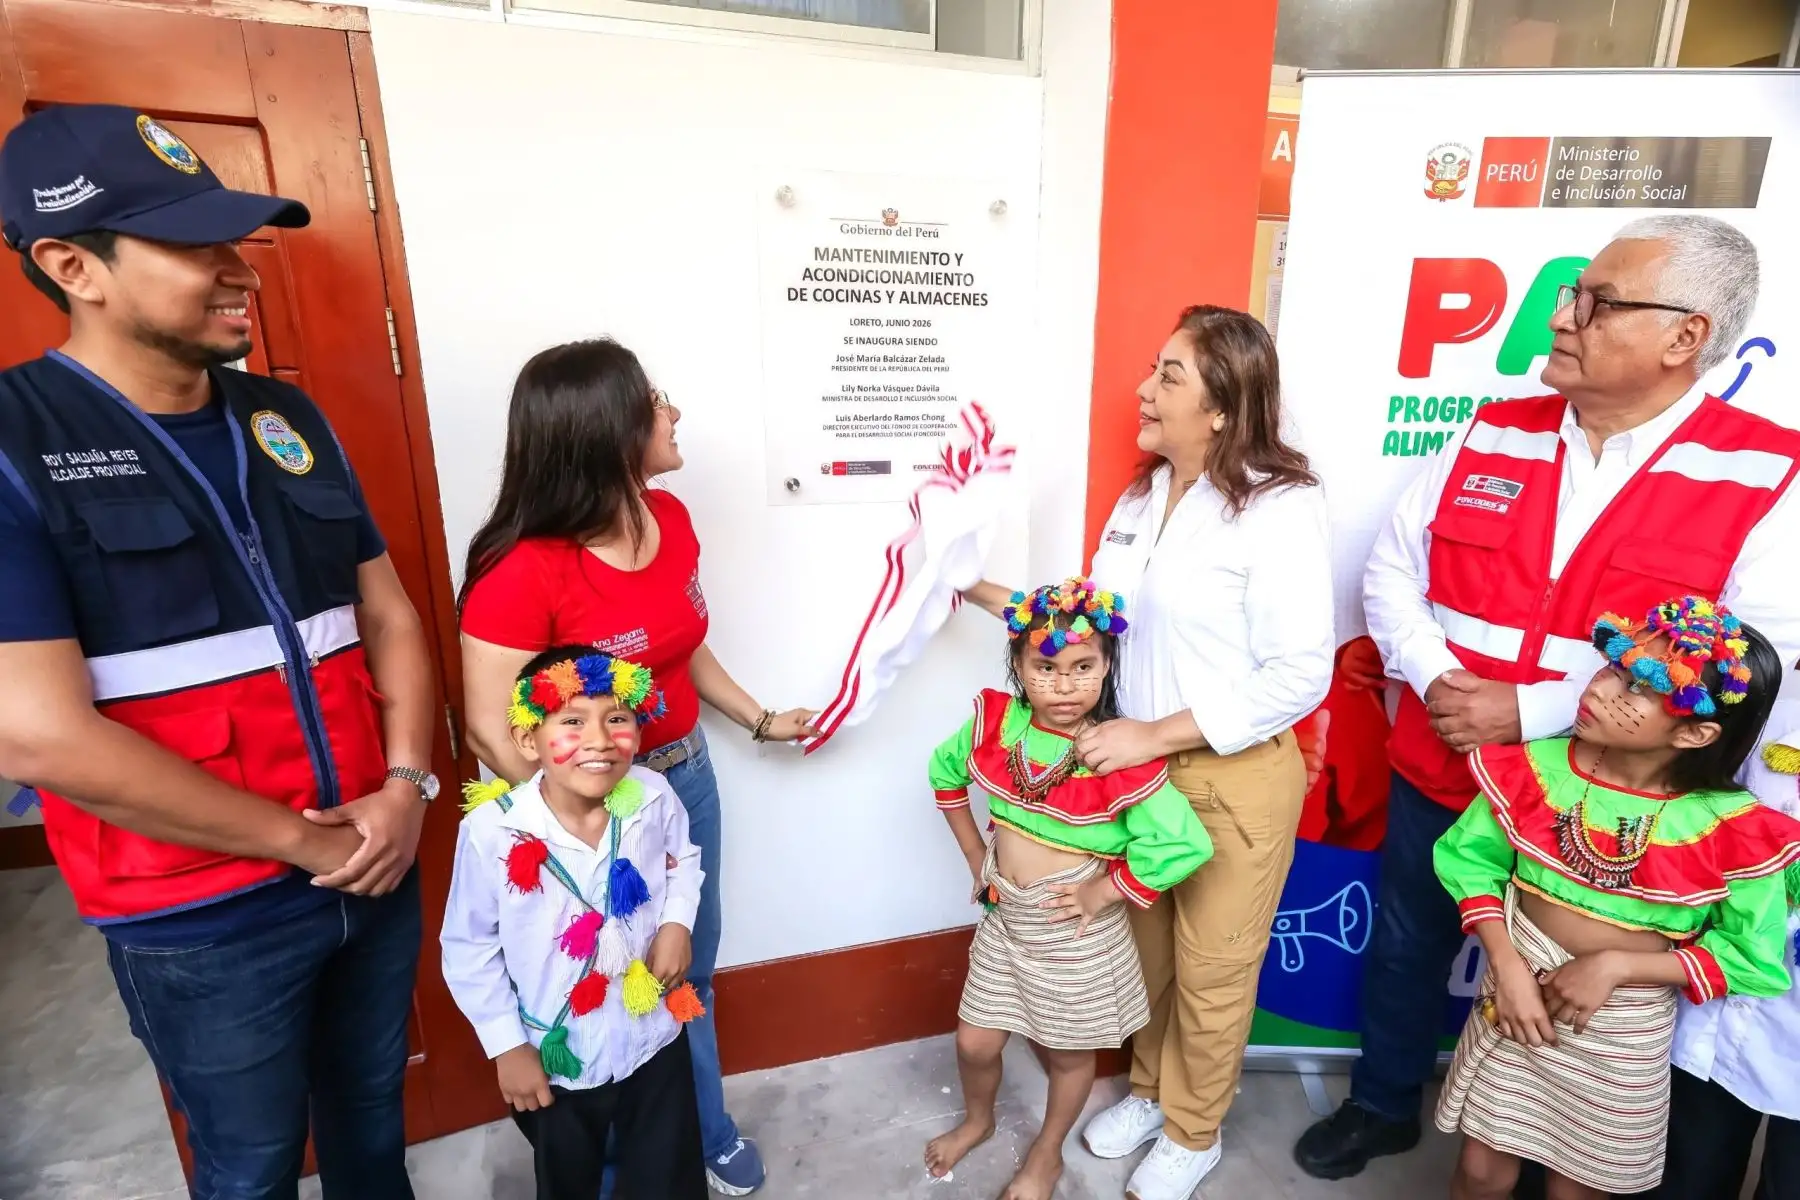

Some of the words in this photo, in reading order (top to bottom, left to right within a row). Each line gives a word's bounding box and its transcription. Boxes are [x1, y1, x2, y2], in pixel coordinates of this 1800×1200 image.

[1271, 131, 1292, 161] A
[1558, 146, 1640, 161] Ministerio
[1486, 160, 1538, 182] PERÚ
[1555, 166, 1574, 181] de
[1580, 166, 1663, 181] Desarrollo
[1551, 189, 1561, 200] e
[1566, 185, 1636, 200] Inclusión
[1641, 185, 1687, 200] Social
[840, 223, 893, 236] Gobierno
[896, 226, 912, 237] del
[916, 227, 939, 239] Perú
[814, 247, 950, 267] MANTENIMIENTO
[954, 253, 963, 266] Y
[802, 268, 974, 287] ACONDICIONAMIENTO
[787, 288, 808, 302] DE
[812, 288, 881, 304] COCINAS
[886, 291, 895, 304] Y
[899, 291, 988, 306] ALMACENES
[849, 318, 884, 327] LORETO,
[886, 319, 910, 327] JUNIO
[912, 319, 932, 327] 2026
[843, 336, 854, 345] SE
[856, 336, 904, 346] INAUGURA
[905, 337, 938, 346] SIENDO
[836, 354, 855, 363] José
[857, 354, 881, 363] María
[883, 354, 917, 363] Balcázar
[919, 355, 945, 363] Zelada
[841, 385, 856, 393] Lily
[857, 385, 881, 393] Norka
[883, 384, 914, 394] Vásquez
[916, 384, 940, 393] Dávila
[1388, 396, 1516, 424] PROGR
[835, 415, 851, 423] Luis
[921, 414, 945, 424] Chong
[1382, 431, 1455, 456] ALIM
[42, 453, 64, 467] ROY
[66, 449, 110, 465] SALDAÑA
[109, 449, 139, 462] REYES
[49, 466, 94, 482] ALCALDE
[92, 463, 147, 477] PROVINCIAL
